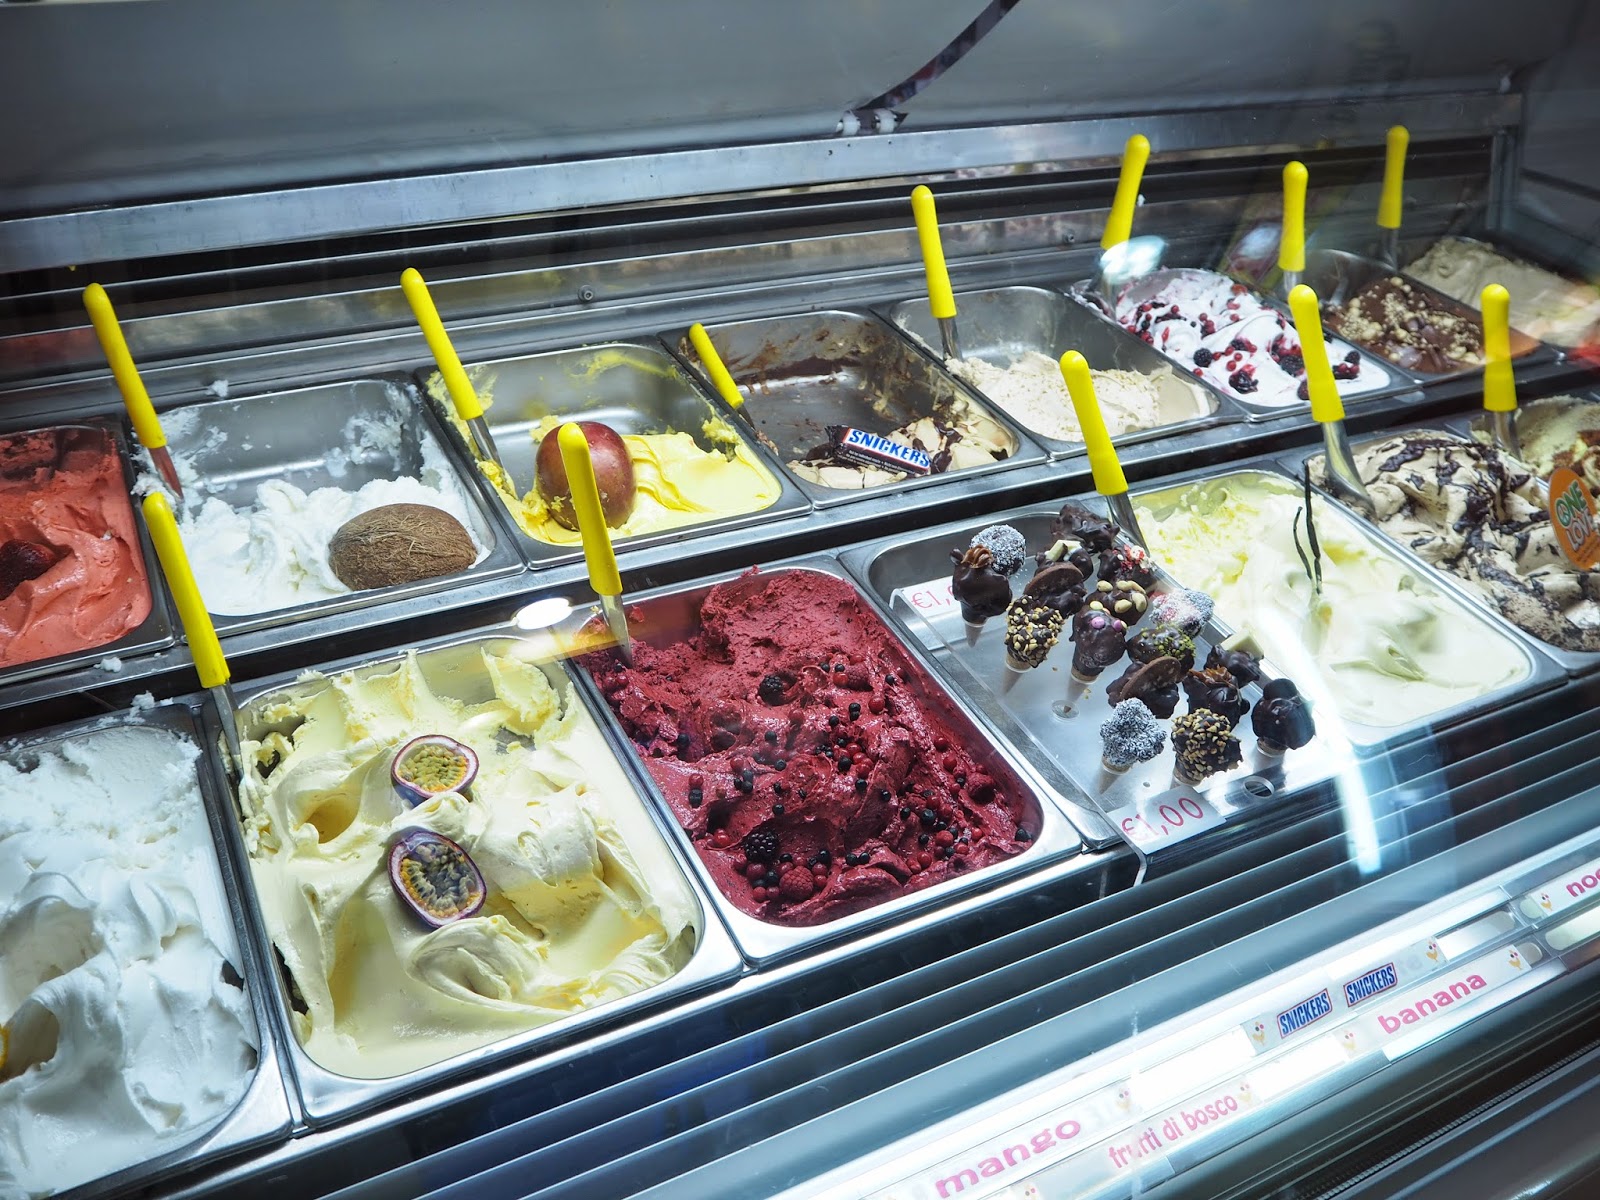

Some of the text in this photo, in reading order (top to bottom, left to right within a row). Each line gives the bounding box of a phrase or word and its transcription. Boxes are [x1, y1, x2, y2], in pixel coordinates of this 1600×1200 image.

[849, 429, 929, 468] SNICKERS
[1555, 480, 1587, 528] ONE
[1280, 967, 1396, 1036] SNICKERS SNICKERS
[1378, 974, 1487, 1034] banana
[1162, 1117, 1184, 1141] di
[1180, 1095, 1238, 1131] bosco
[935, 1120, 1081, 1199] mango
